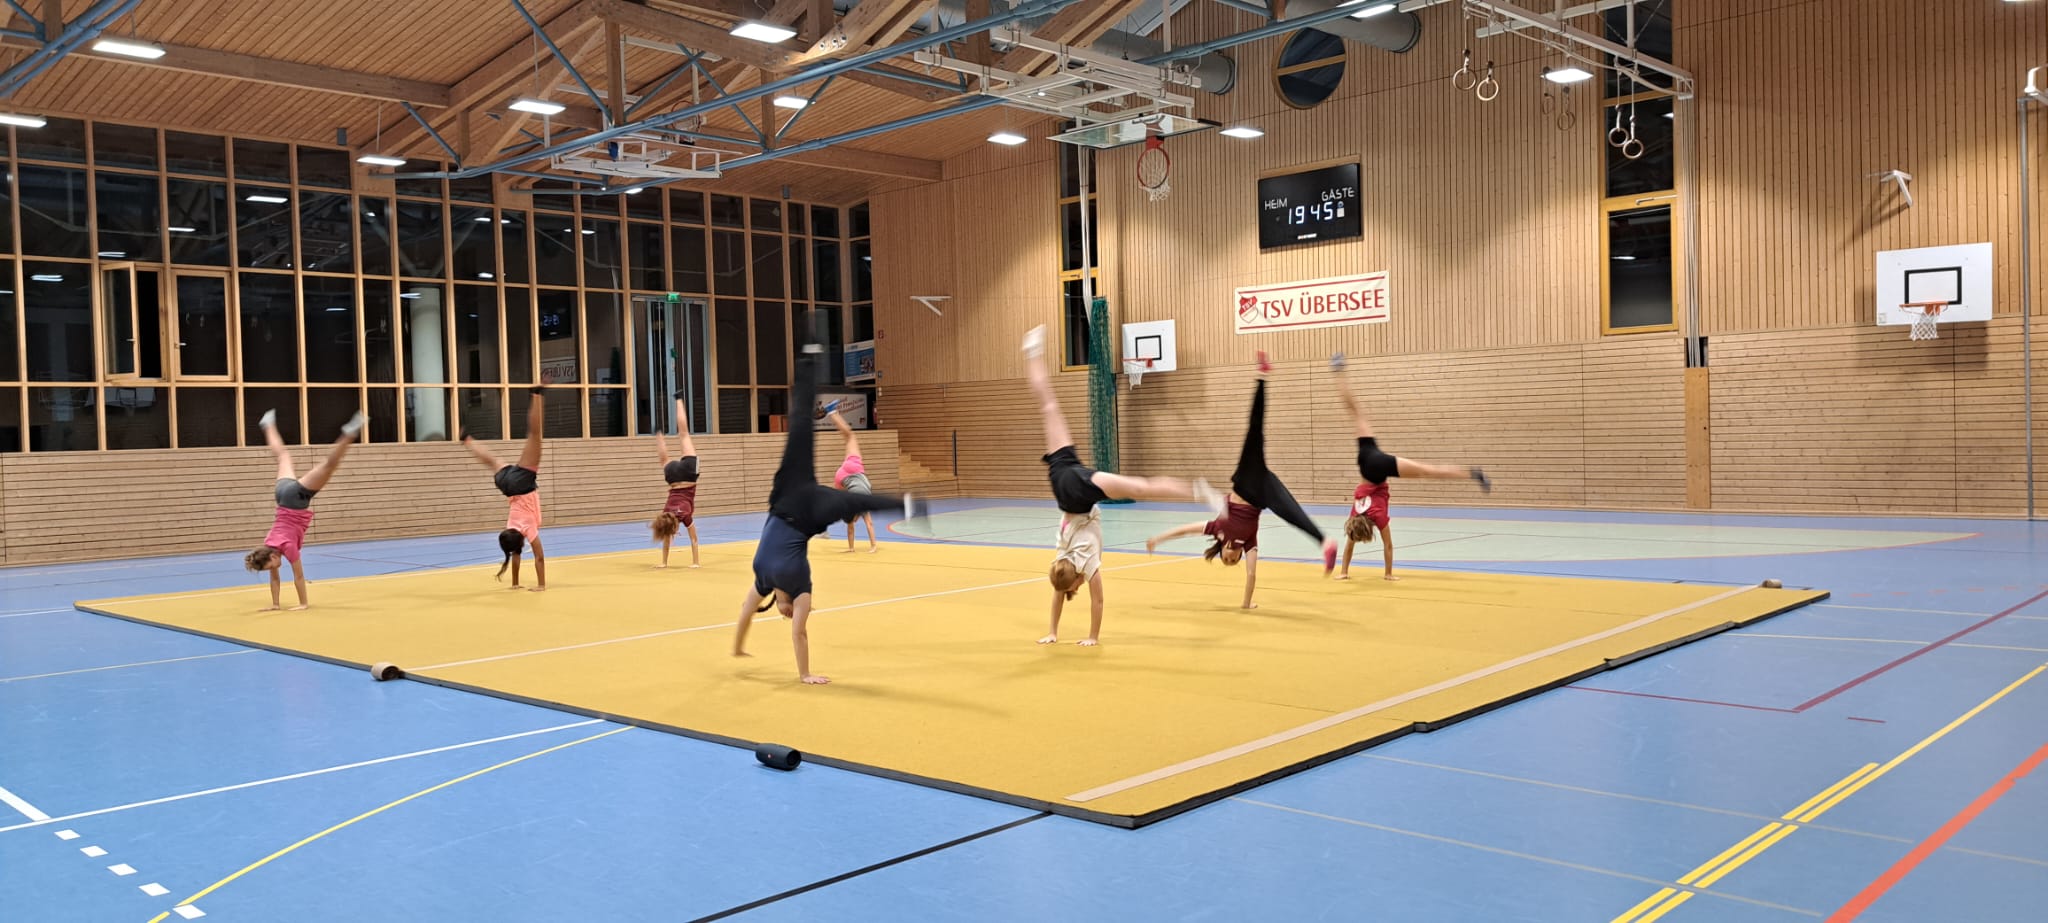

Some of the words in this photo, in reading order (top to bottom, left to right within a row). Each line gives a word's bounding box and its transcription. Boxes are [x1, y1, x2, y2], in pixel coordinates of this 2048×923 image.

[1264, 197, 1288, 211] HEIM
[1261, 298, 1293, 319] TSV
[1299, 288, 1385, 316] ÜBERSEE
